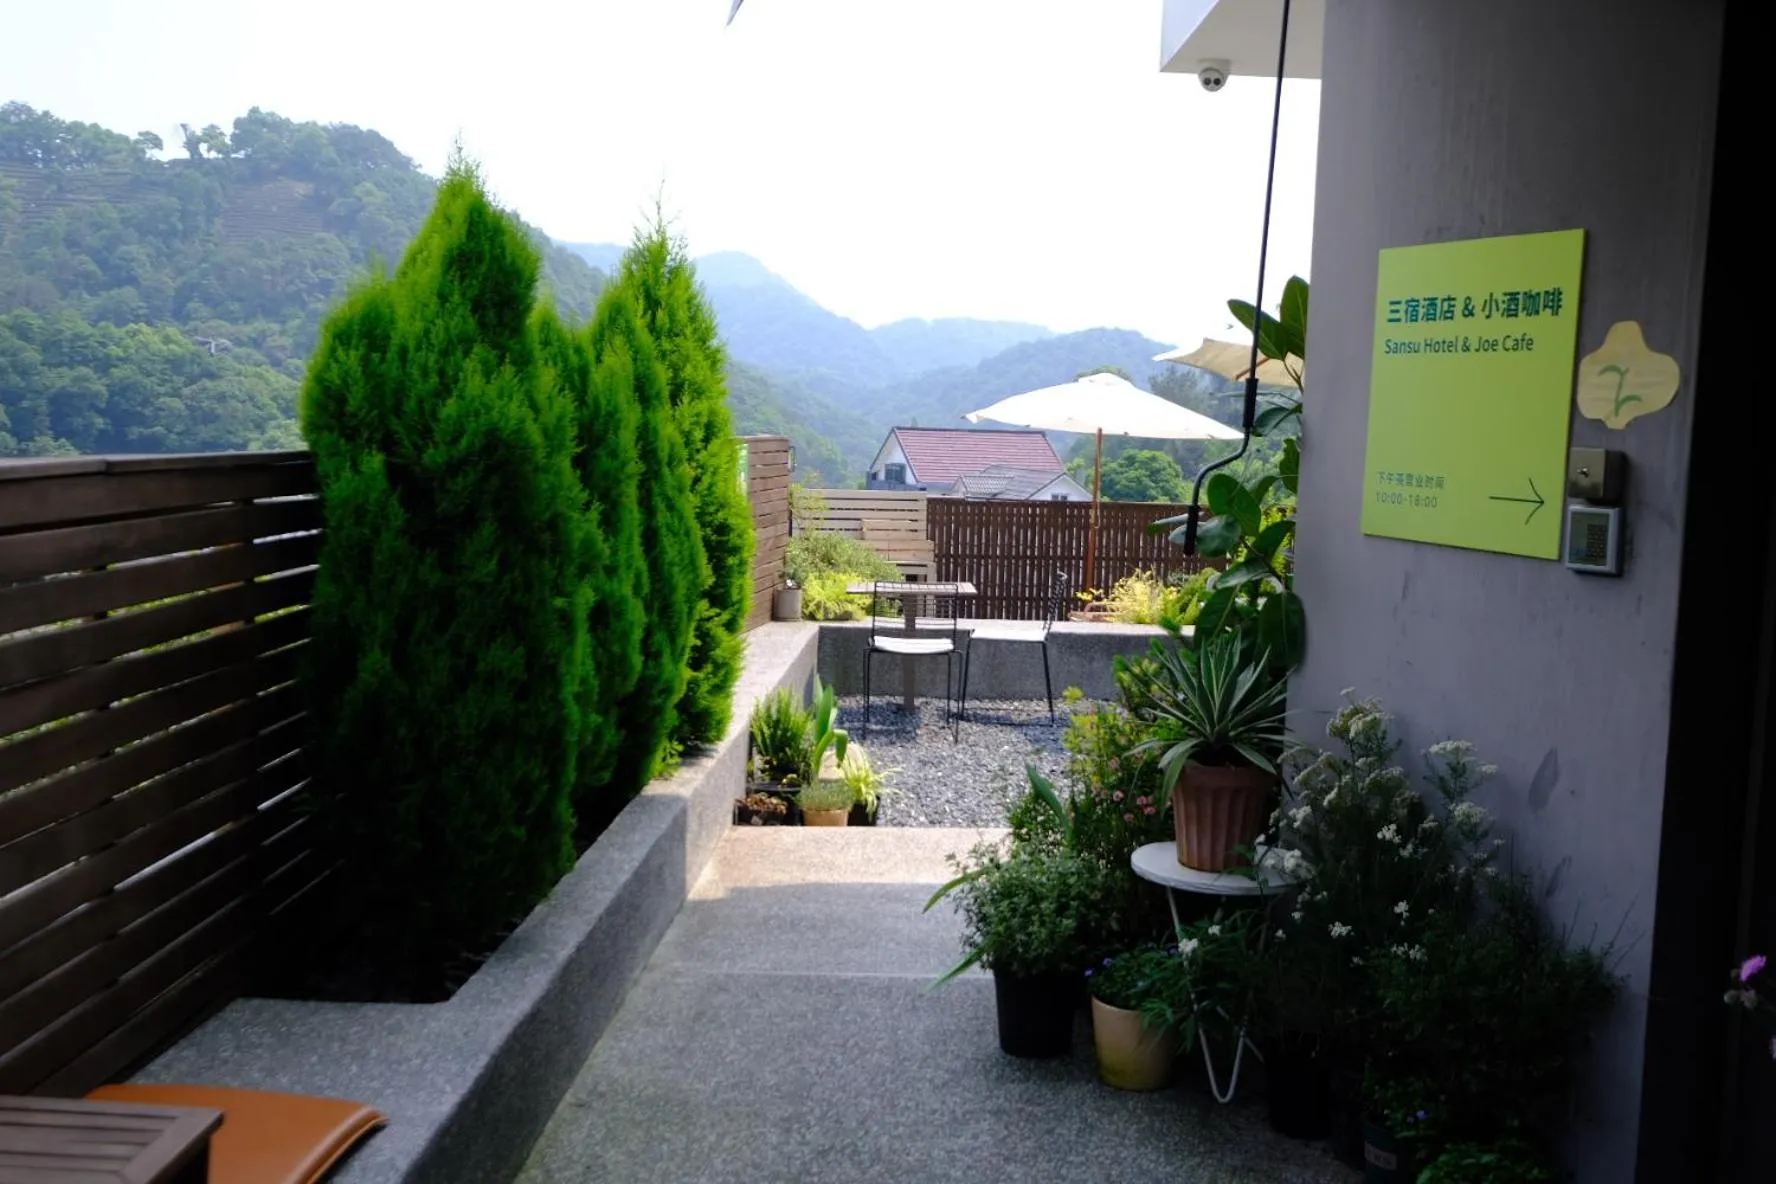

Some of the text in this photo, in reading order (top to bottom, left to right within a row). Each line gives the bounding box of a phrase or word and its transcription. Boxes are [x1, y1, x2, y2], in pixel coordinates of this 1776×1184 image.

[1387, 287, 1563, 323] 三宿酒店 & 小酒咖啡
[1384, 333, 1534, 354] Sansu Hotel & Joe Cafe
